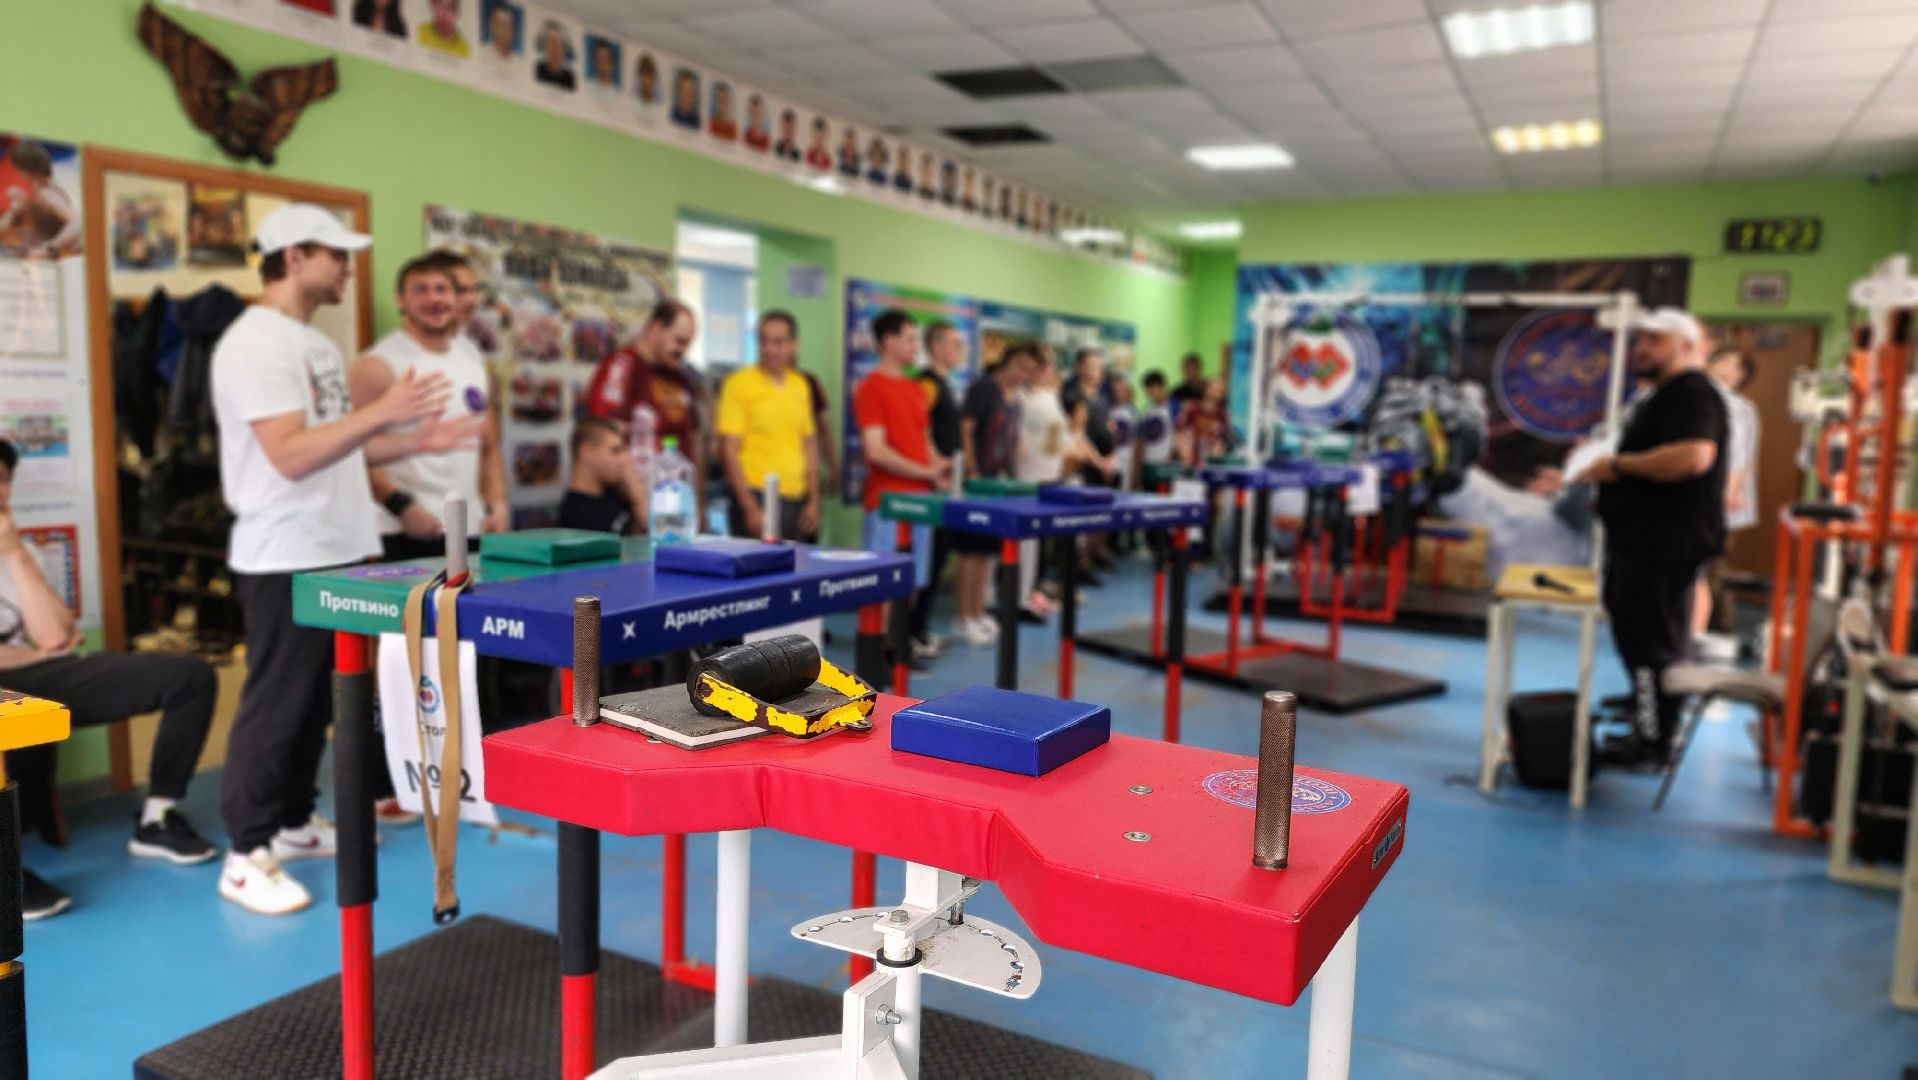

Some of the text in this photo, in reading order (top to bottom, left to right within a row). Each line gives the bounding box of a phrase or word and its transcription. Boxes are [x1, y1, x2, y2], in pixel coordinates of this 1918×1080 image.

[319, 590, 399, 618] Протвино
[664, 595, 772, 631] Армрестлинг
[482, 615, 525, 640] АРМ
